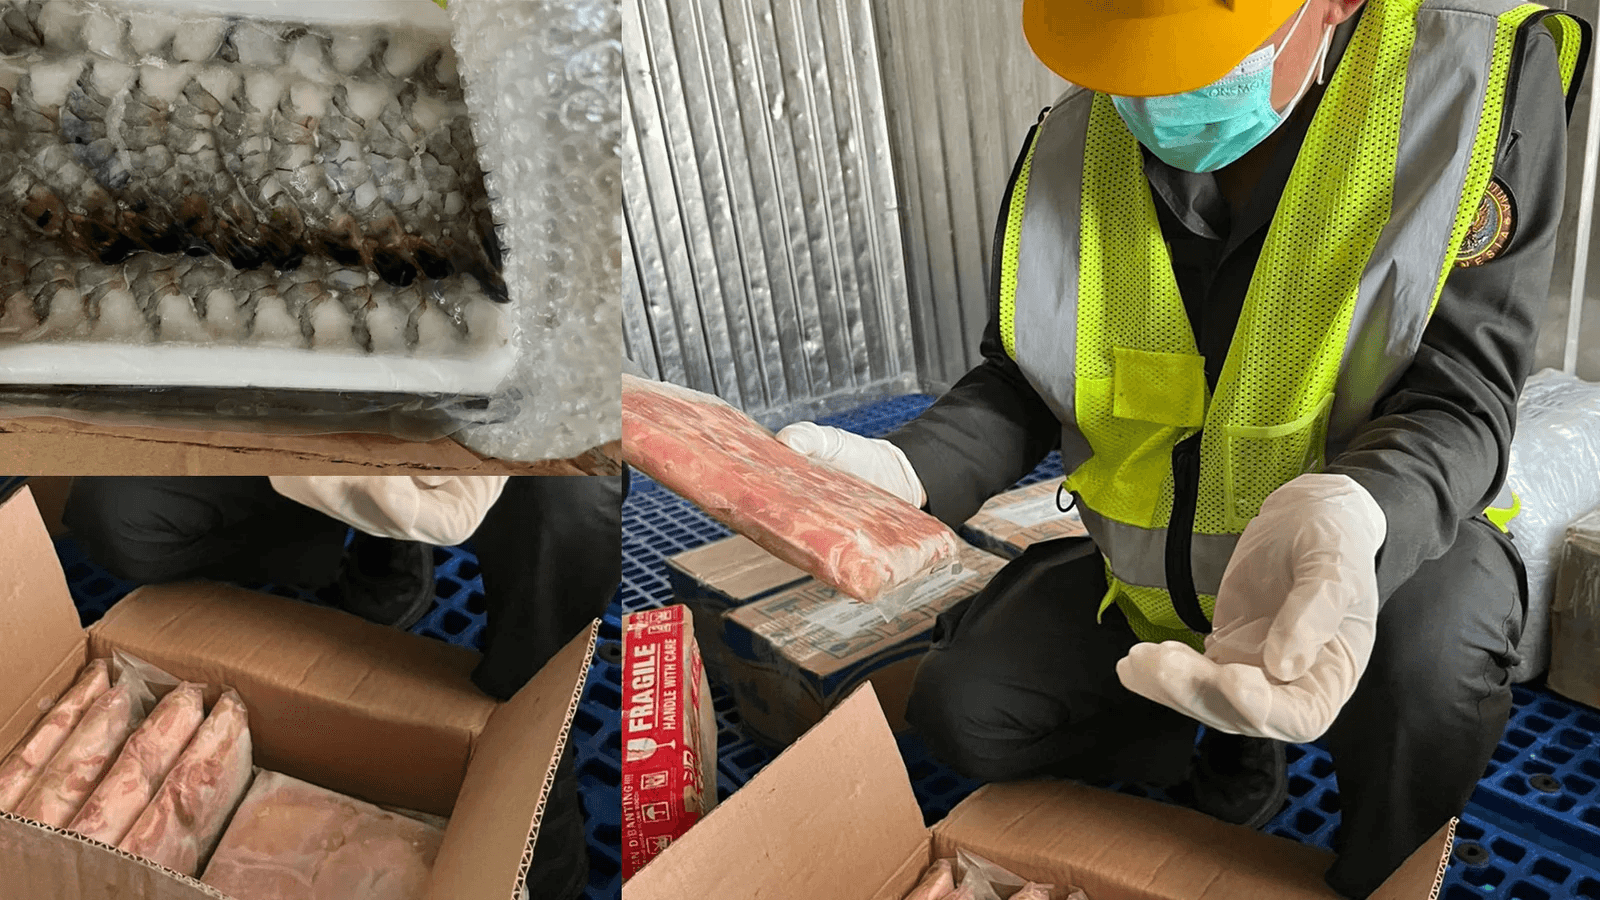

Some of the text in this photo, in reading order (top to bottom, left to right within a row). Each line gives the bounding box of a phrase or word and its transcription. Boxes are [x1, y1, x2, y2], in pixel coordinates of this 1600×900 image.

[628, 643, 656, 733] FRAGILE
[662, 639, 677, 730] HANDLE WITH CARE
